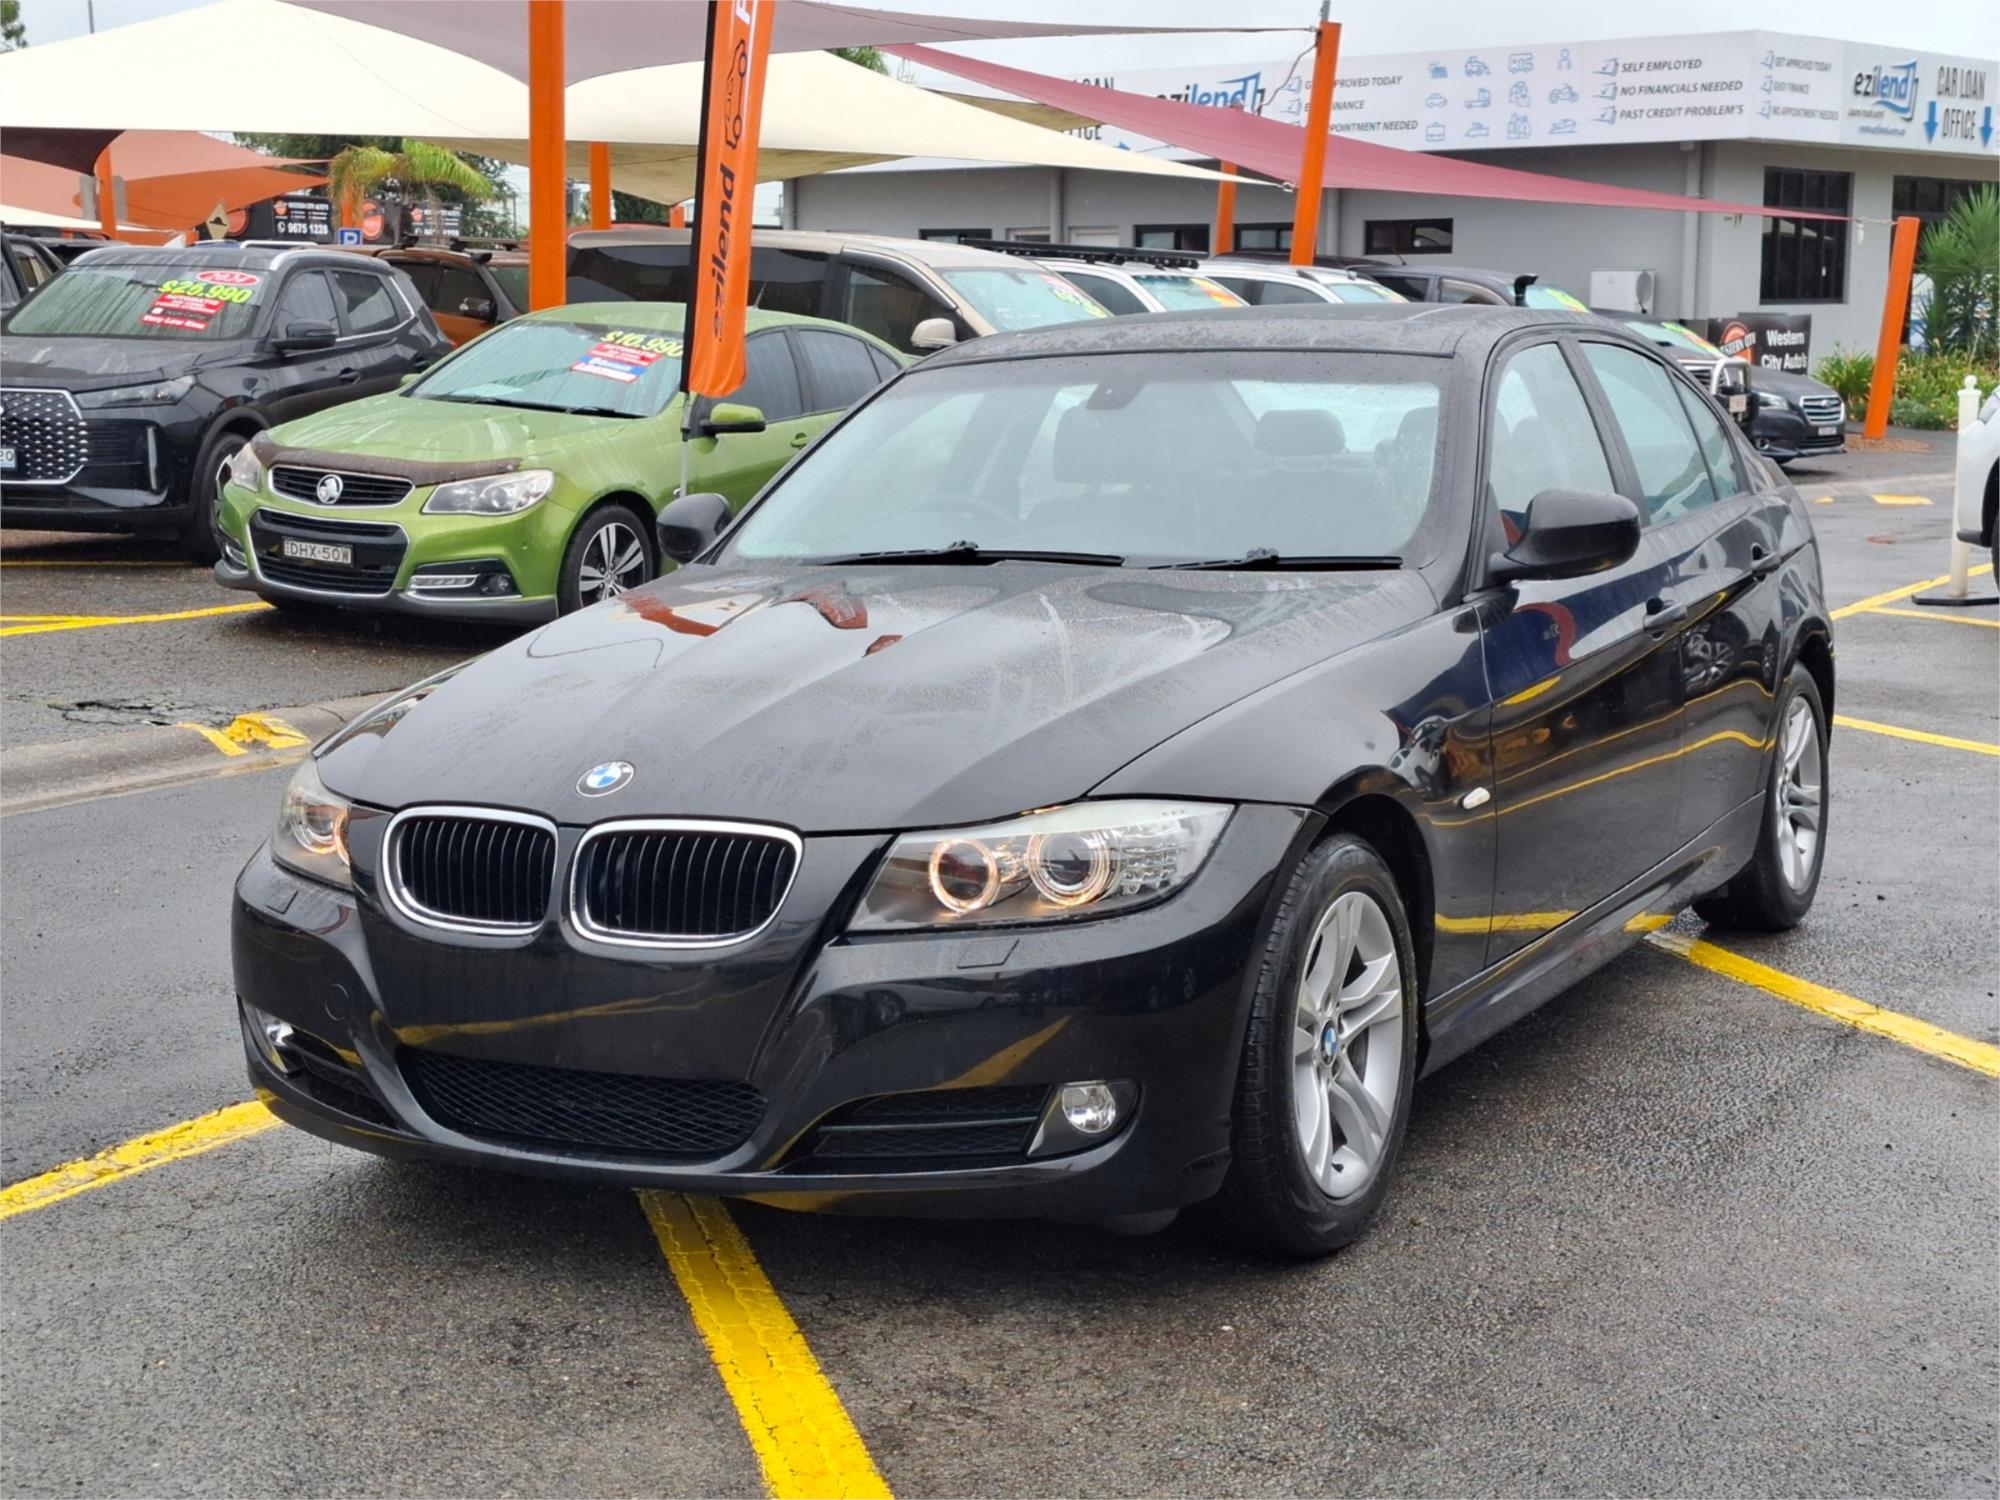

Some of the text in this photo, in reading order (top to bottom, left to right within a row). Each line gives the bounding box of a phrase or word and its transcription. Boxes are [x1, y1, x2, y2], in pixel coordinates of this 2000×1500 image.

[1622, 59, 1703, 73] SELF EMPLOYED
[1372, 75, 1403, 86] TODAY
[1620, 80, 1743, 96] NO FINANCIALS NEEDED
[1853, 65, 1909, 100] ezilend
[1937, 66, 1986, 100] CAR LOAN
[1619, 104, 1745, 120] PAST CREDIT PROBLEM'S
[1383, 120, 1419, 131] NEEDED
[1942, 107, 1976, 140] OFFICE
[1766, 329, 1805, 346] Western
[1761, 354, 1782, 370] City
